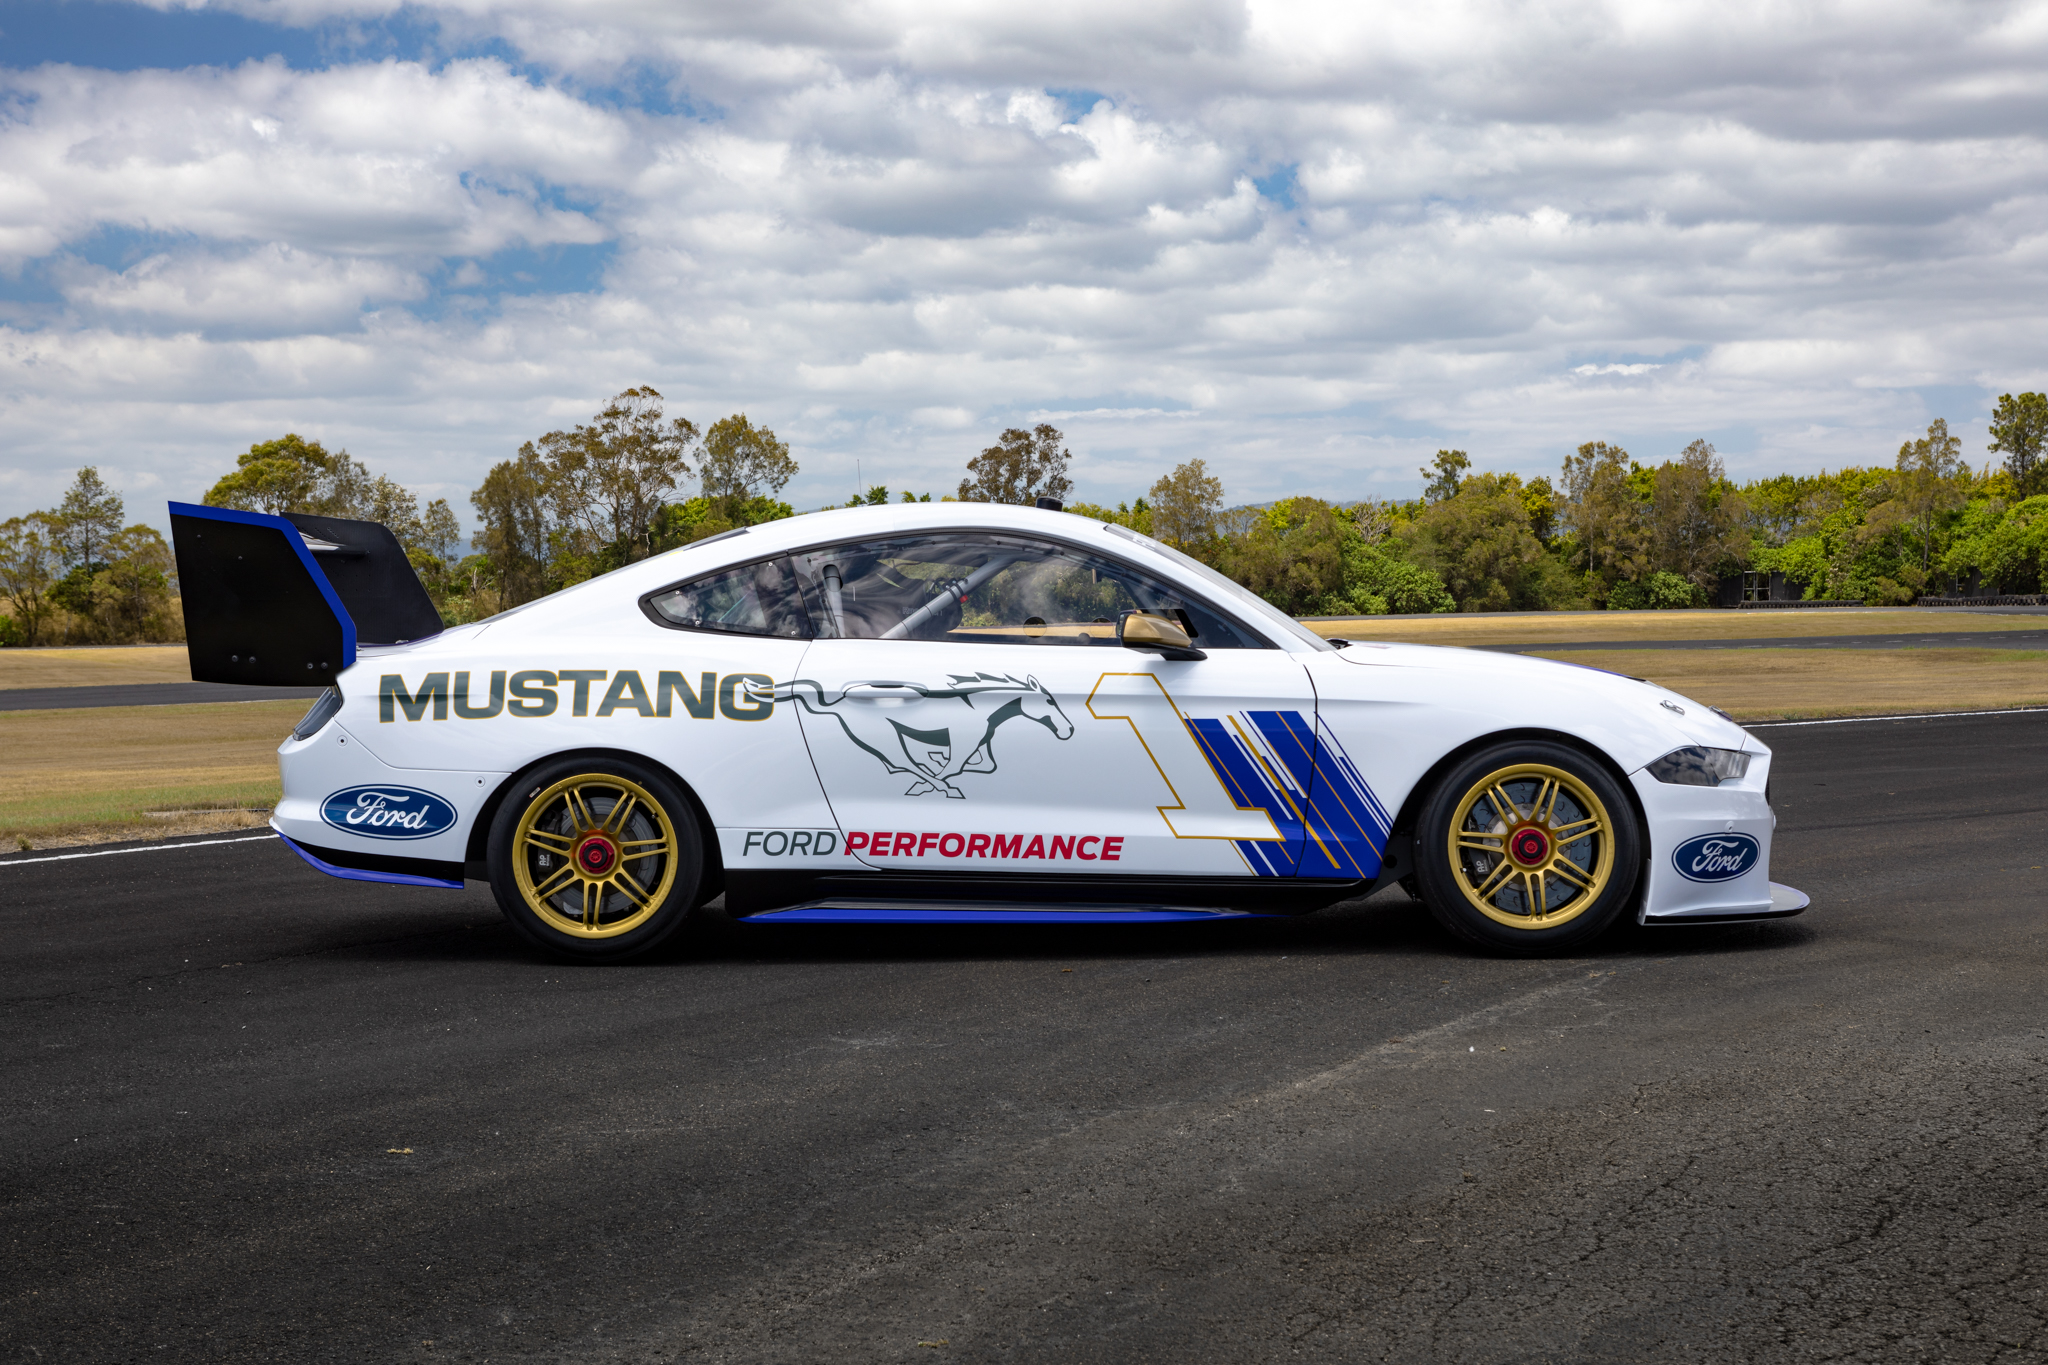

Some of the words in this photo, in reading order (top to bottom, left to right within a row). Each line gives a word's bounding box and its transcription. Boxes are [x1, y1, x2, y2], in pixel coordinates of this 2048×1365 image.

[379, 670, 775, 722] MUSTANG
[1085, 672, 1287, 842] 1
[346, 791, 430, 830] Ford
[742, 831, 838, 857] FORD
[844, 831, 1125, 861] PERFORMANCE
[1691, 839, 1749, 873] Ford
